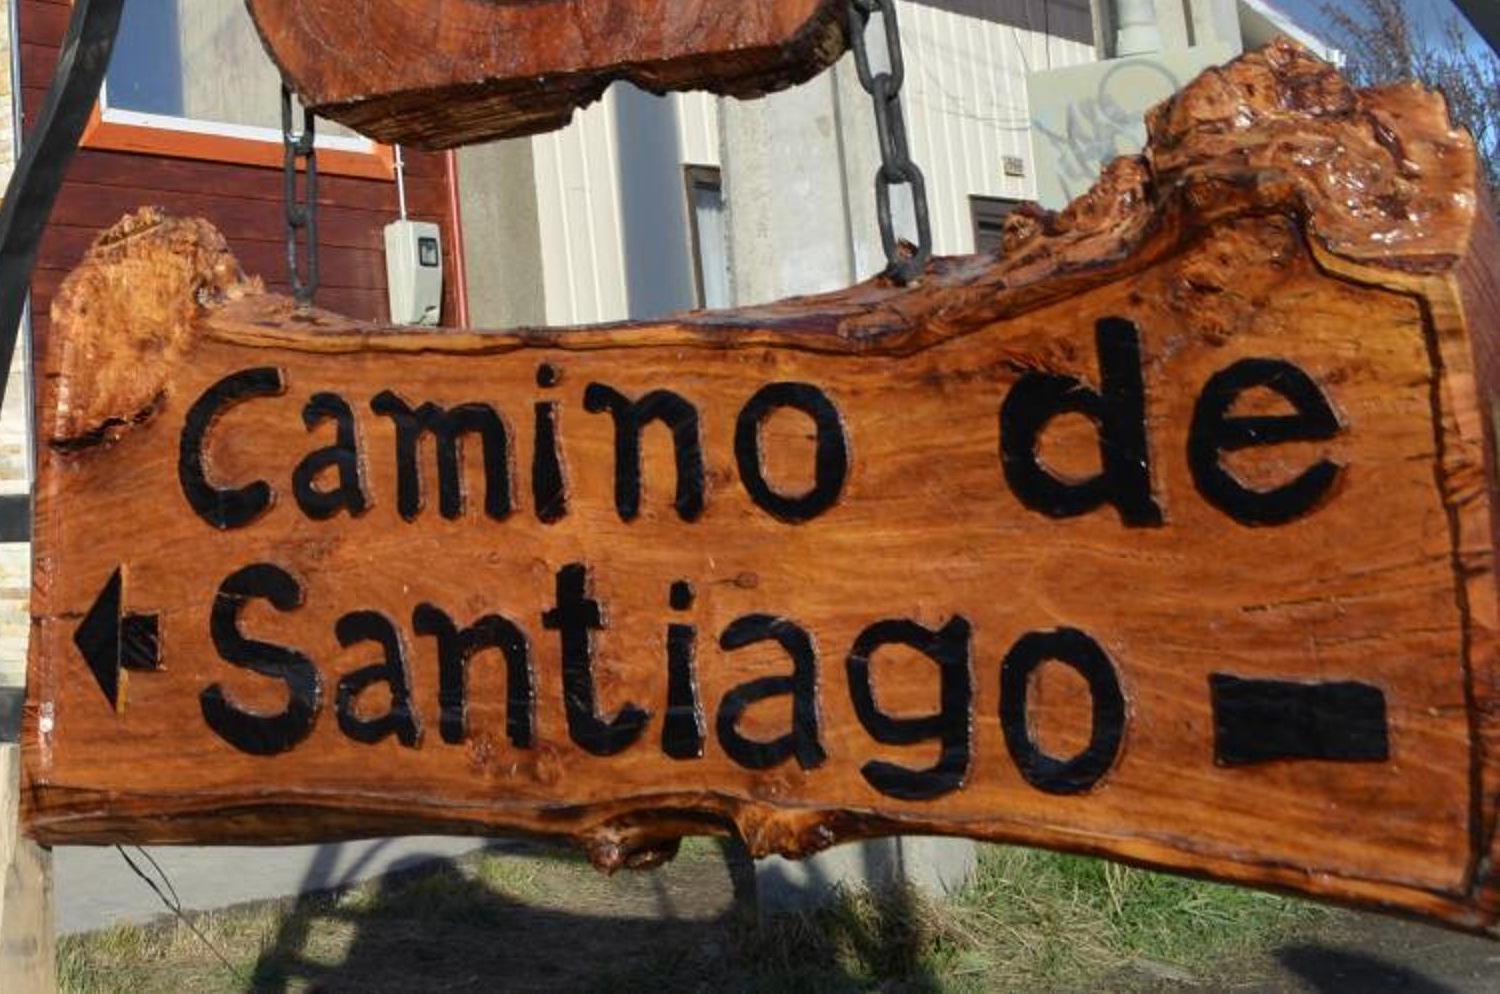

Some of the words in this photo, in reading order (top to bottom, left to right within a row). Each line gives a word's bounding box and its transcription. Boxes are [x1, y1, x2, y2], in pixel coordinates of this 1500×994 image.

[179, 362, 850, 529] Camino
[1000, 317, 1348, 527] de
[199, 562, 1131, 801] Santiago
